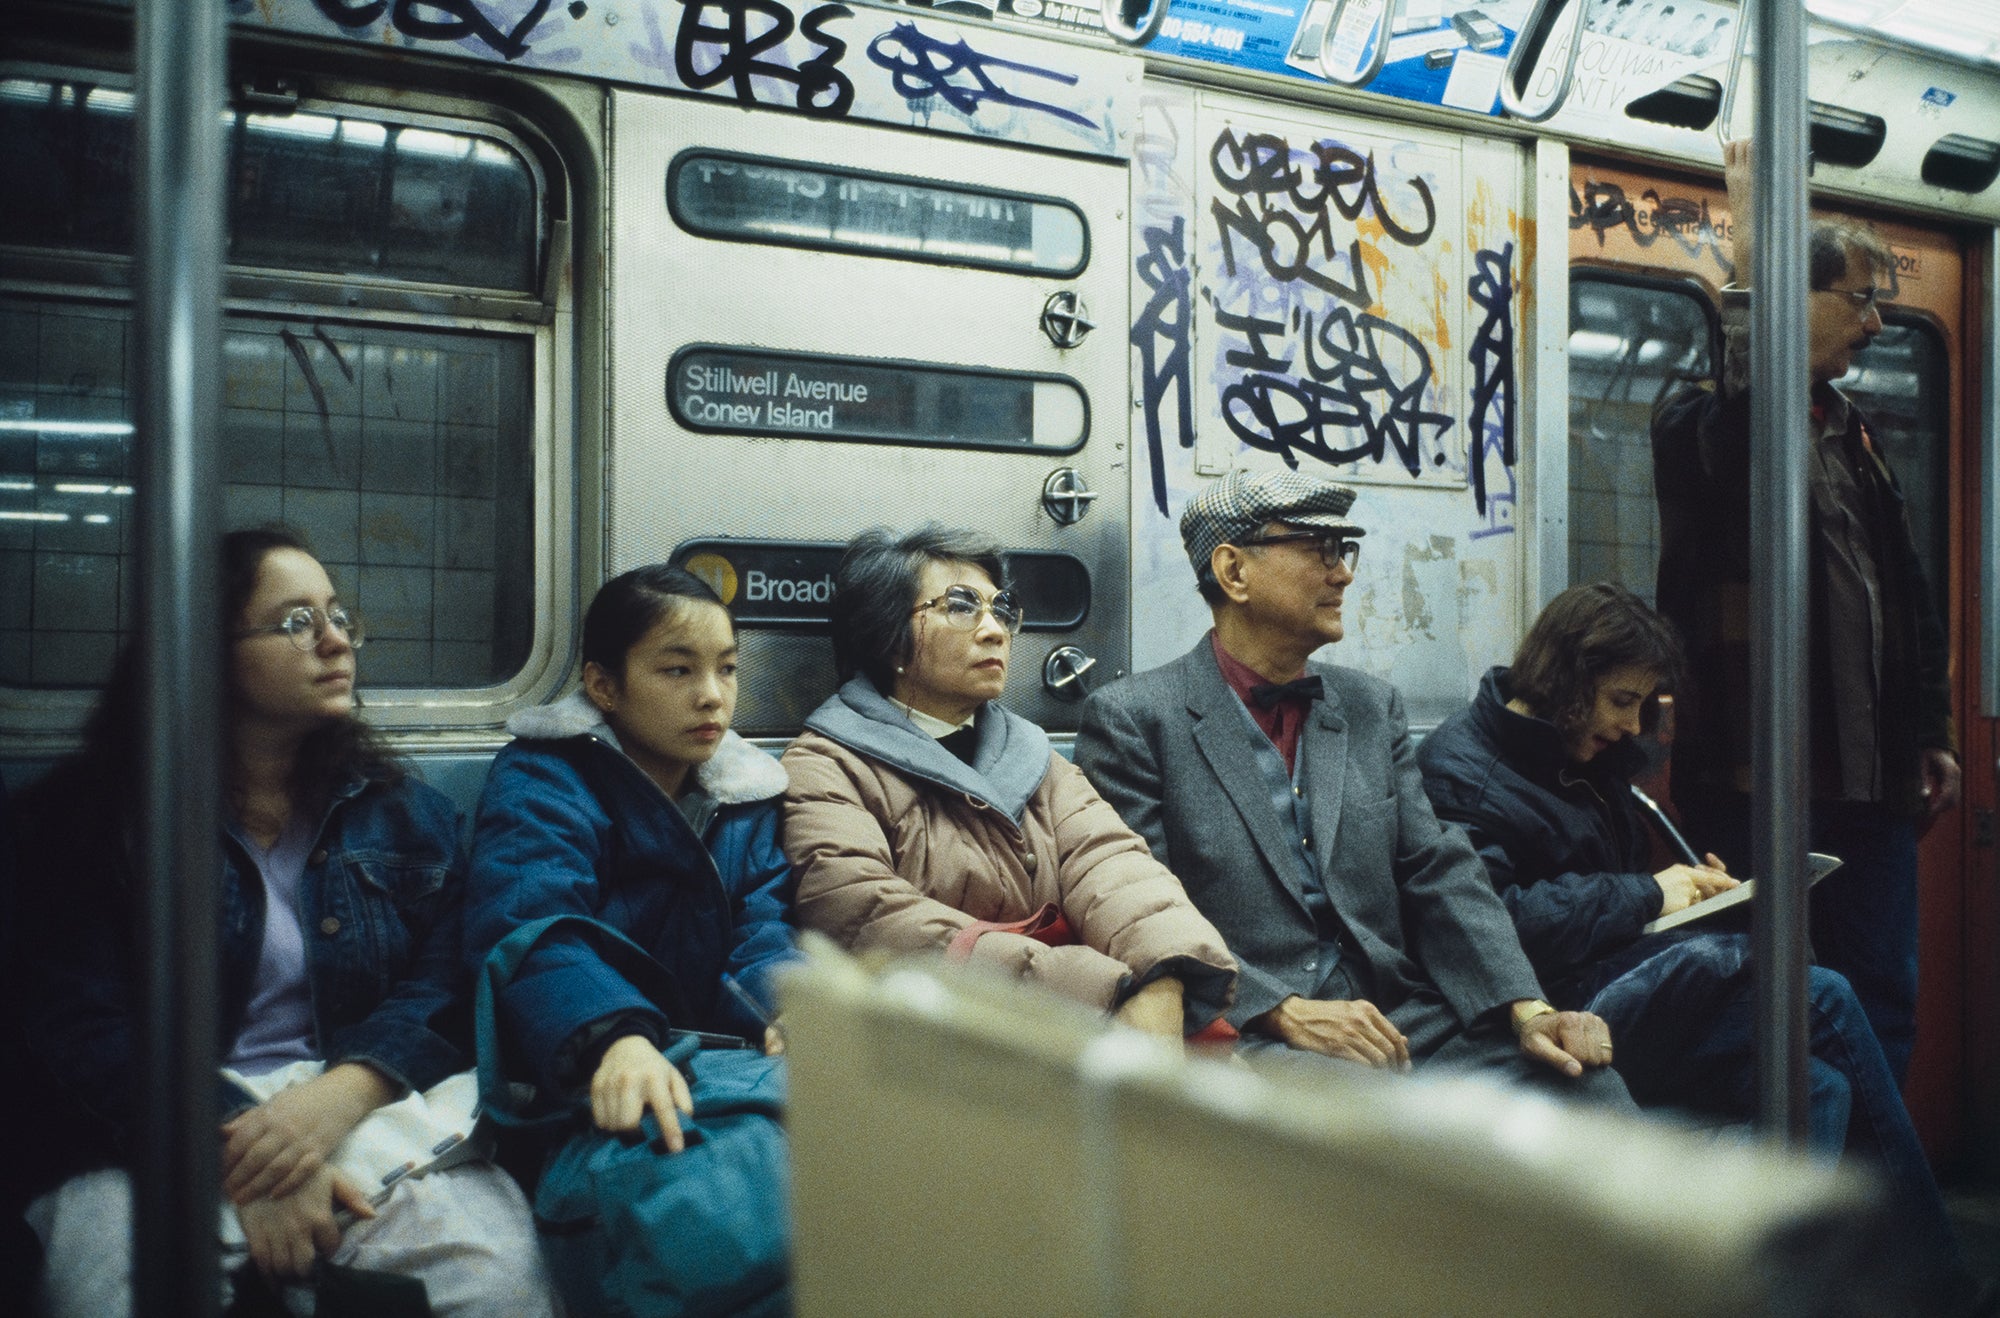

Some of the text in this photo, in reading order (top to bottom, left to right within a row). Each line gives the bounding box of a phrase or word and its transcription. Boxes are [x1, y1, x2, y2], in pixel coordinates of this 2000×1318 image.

[685, 363, 869, 404] Stillwell Avenue
[767, 400, 834, 430] Island
[746, 570, 837, 604] Broad
